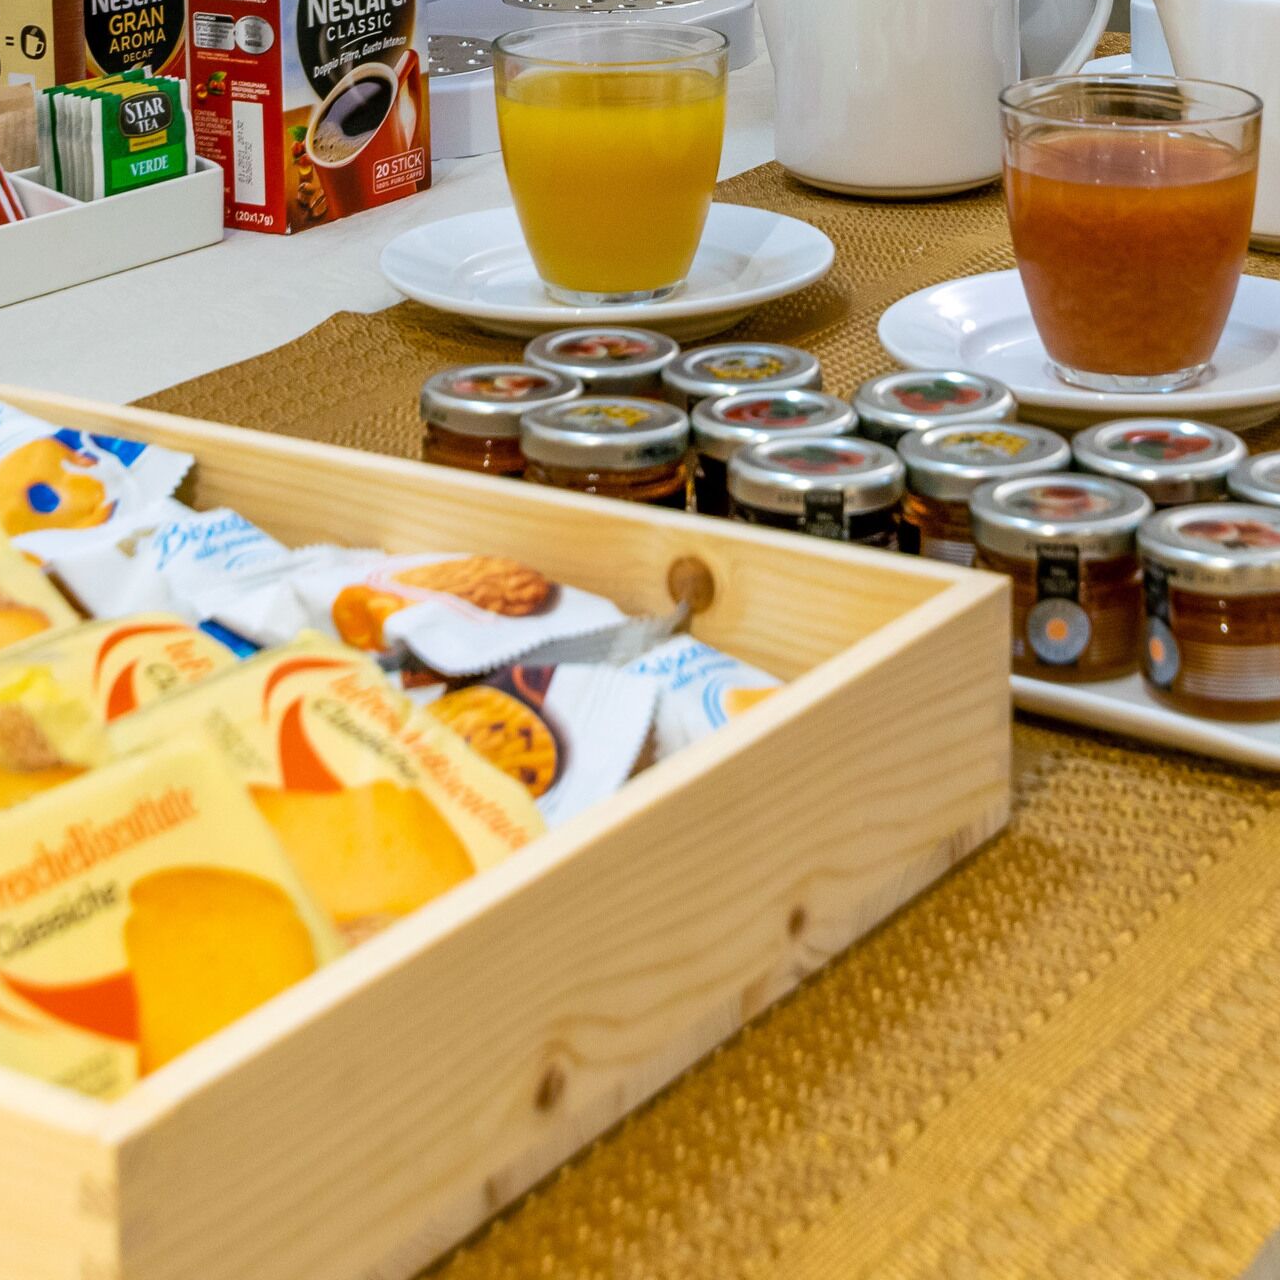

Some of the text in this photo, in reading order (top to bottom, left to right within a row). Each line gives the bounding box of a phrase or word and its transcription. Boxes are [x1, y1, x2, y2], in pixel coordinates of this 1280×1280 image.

[108, 4, 165, 36] GRAN
[326, 12, 392, 41] CLASSIC
[109, 27, 166, 55] AROMA
[123, 47, 153, 64] DECAF
[313, 57, 339, 79] Doppio
[362, 41, 382, 56] Gusto
[383, 35, 407, 49] Intenso
[124, 96, 166, 124] STAR
[136, 118, 159, 133] TEA
[130, 155, 169, 177] VERDE
[376, 151, 422, 179] 20 STICK
